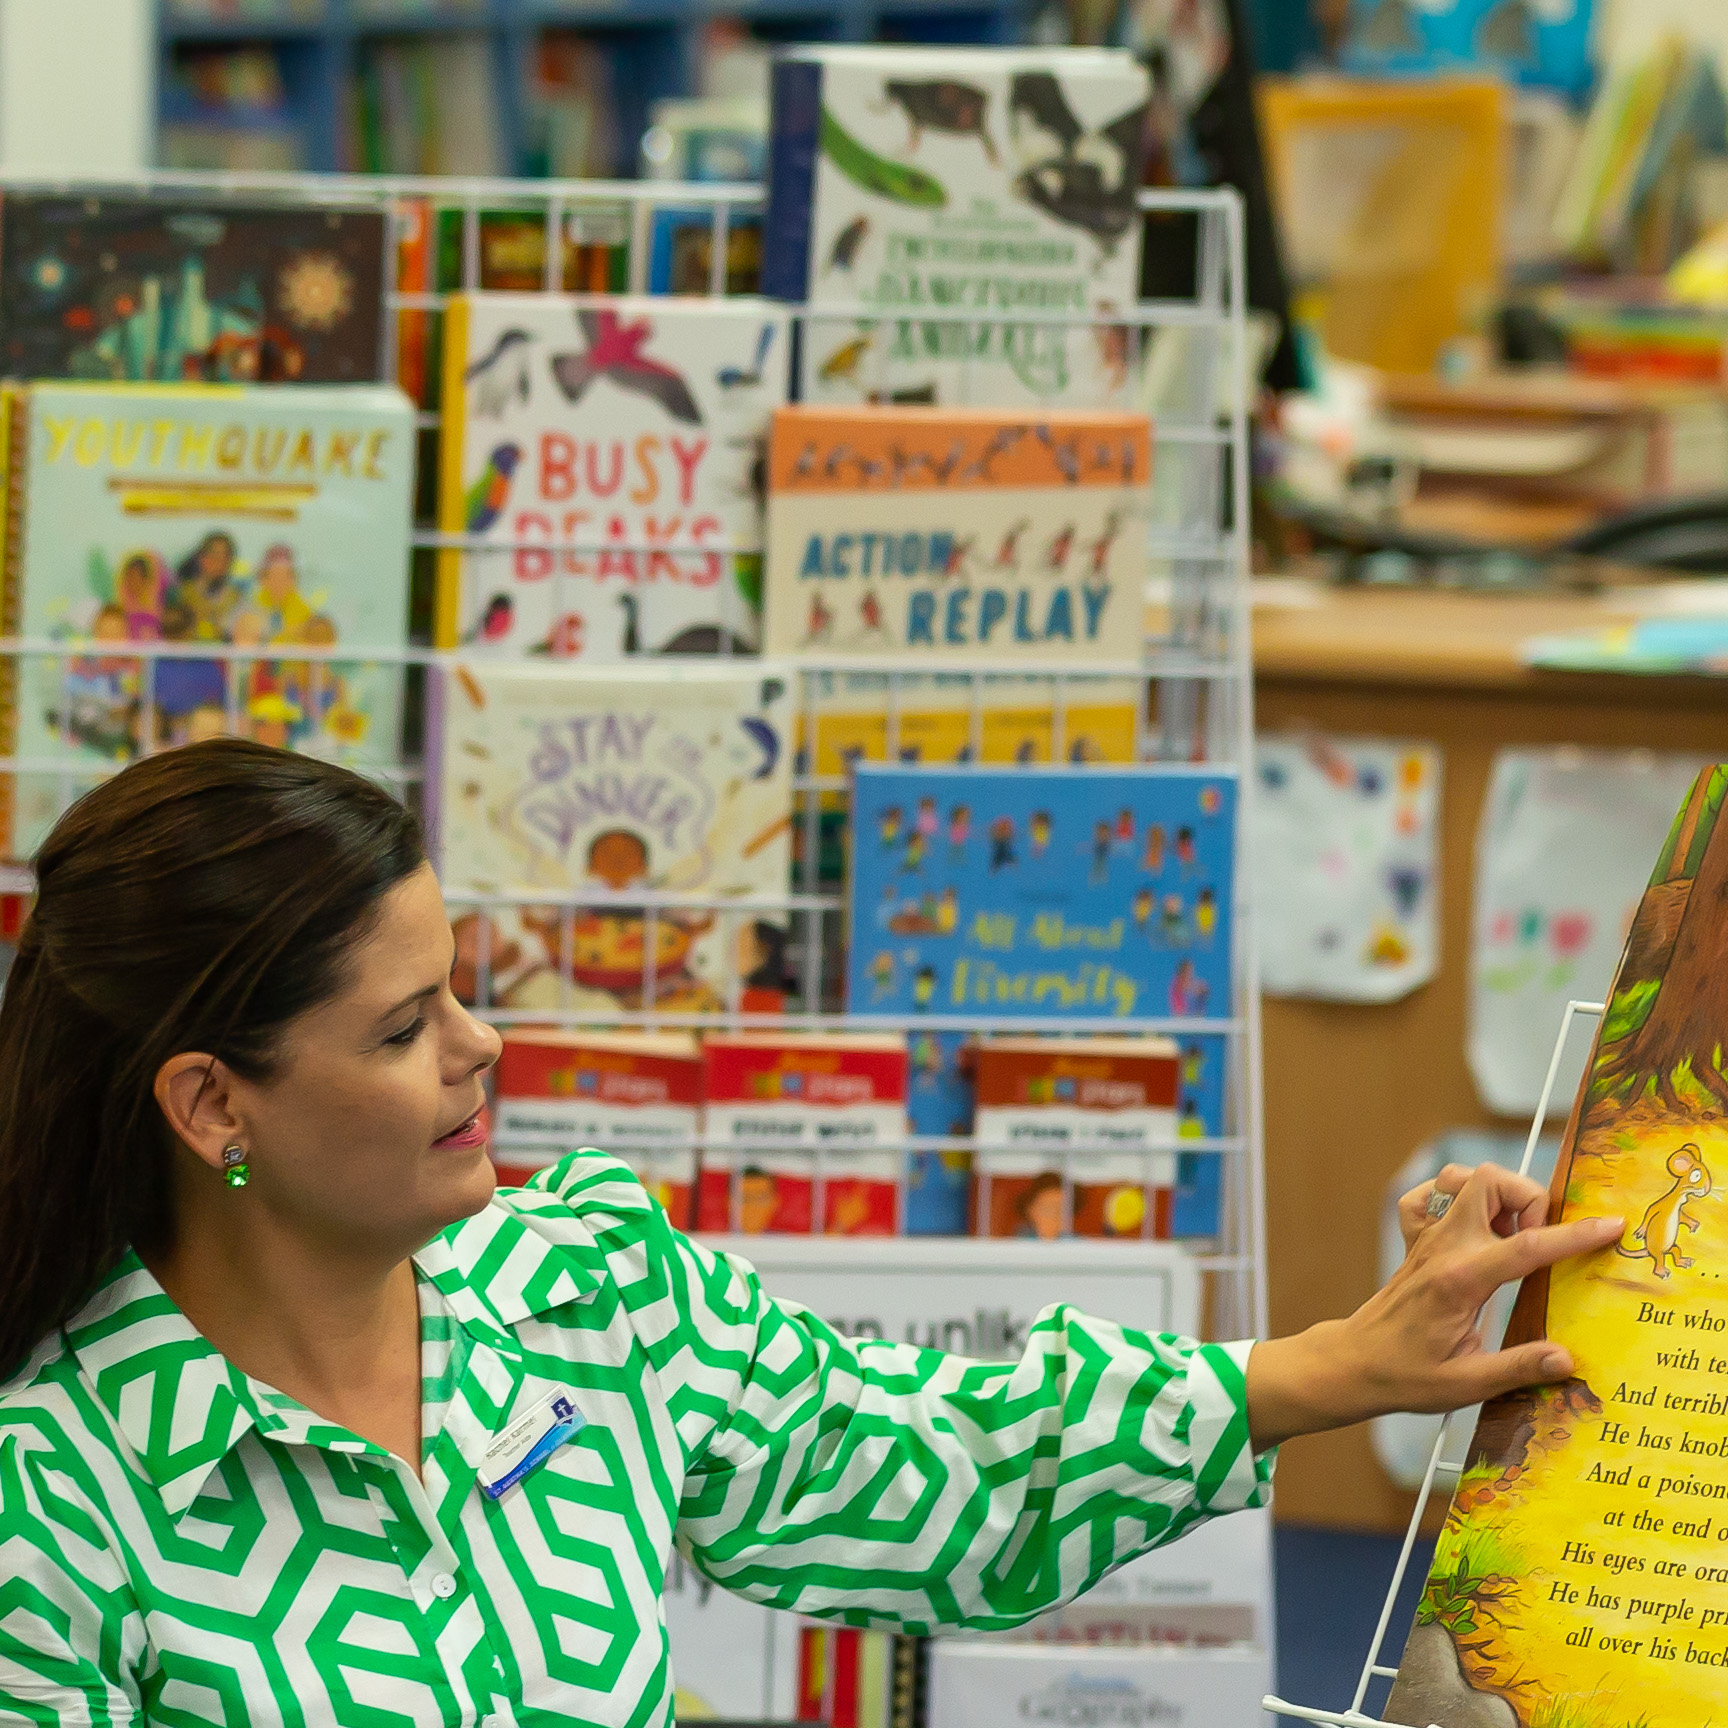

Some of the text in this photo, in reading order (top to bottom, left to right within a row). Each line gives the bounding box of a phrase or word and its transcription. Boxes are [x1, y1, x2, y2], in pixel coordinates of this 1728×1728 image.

[41, 413, 393, 482] YOUTHQUAKE
[537, 429, 708, 505] BUSY
[513, 508, 723, 589] BEAKS
[798, 528, 956, 580] ACTION
[905, 581, 1112, 647] REPLAY
[906, 1307, 1029, 1360] unlik
[1635, 1301, 1676, 1326] But
[1684, 1309, 1726, 1333] who
[1656, 1347, 1700, 1371] with
[1610, 1381, 1658, 1407] And
[1598, 1421, 1630, 1445] He
[1636, 1425, 1673, 1451] has
[1585, 1461, 1633, 1486] And
[1637, 1475, 1652, 1489] a
[1603, 1510, 1626, 1528] at
[1632, 1509, 1664, 1533] the
[1672, 1517, 1713, 1539] end
[1559, 1540, 1596, 1565] His
[1602, 1553, 1647, 1576] eyes
[1653, 1560, 1687, 1578] are
[1547, 1580, 1579, 1604] He
[1585, 1585, 1622, 1611] has
[1624, 1597, 1694, 1625] purple
[1565, 1626, 1594, 1648] all
[1598, 1636, 1644, 1655] over
[1648, 1636, 1678, 1661] his
